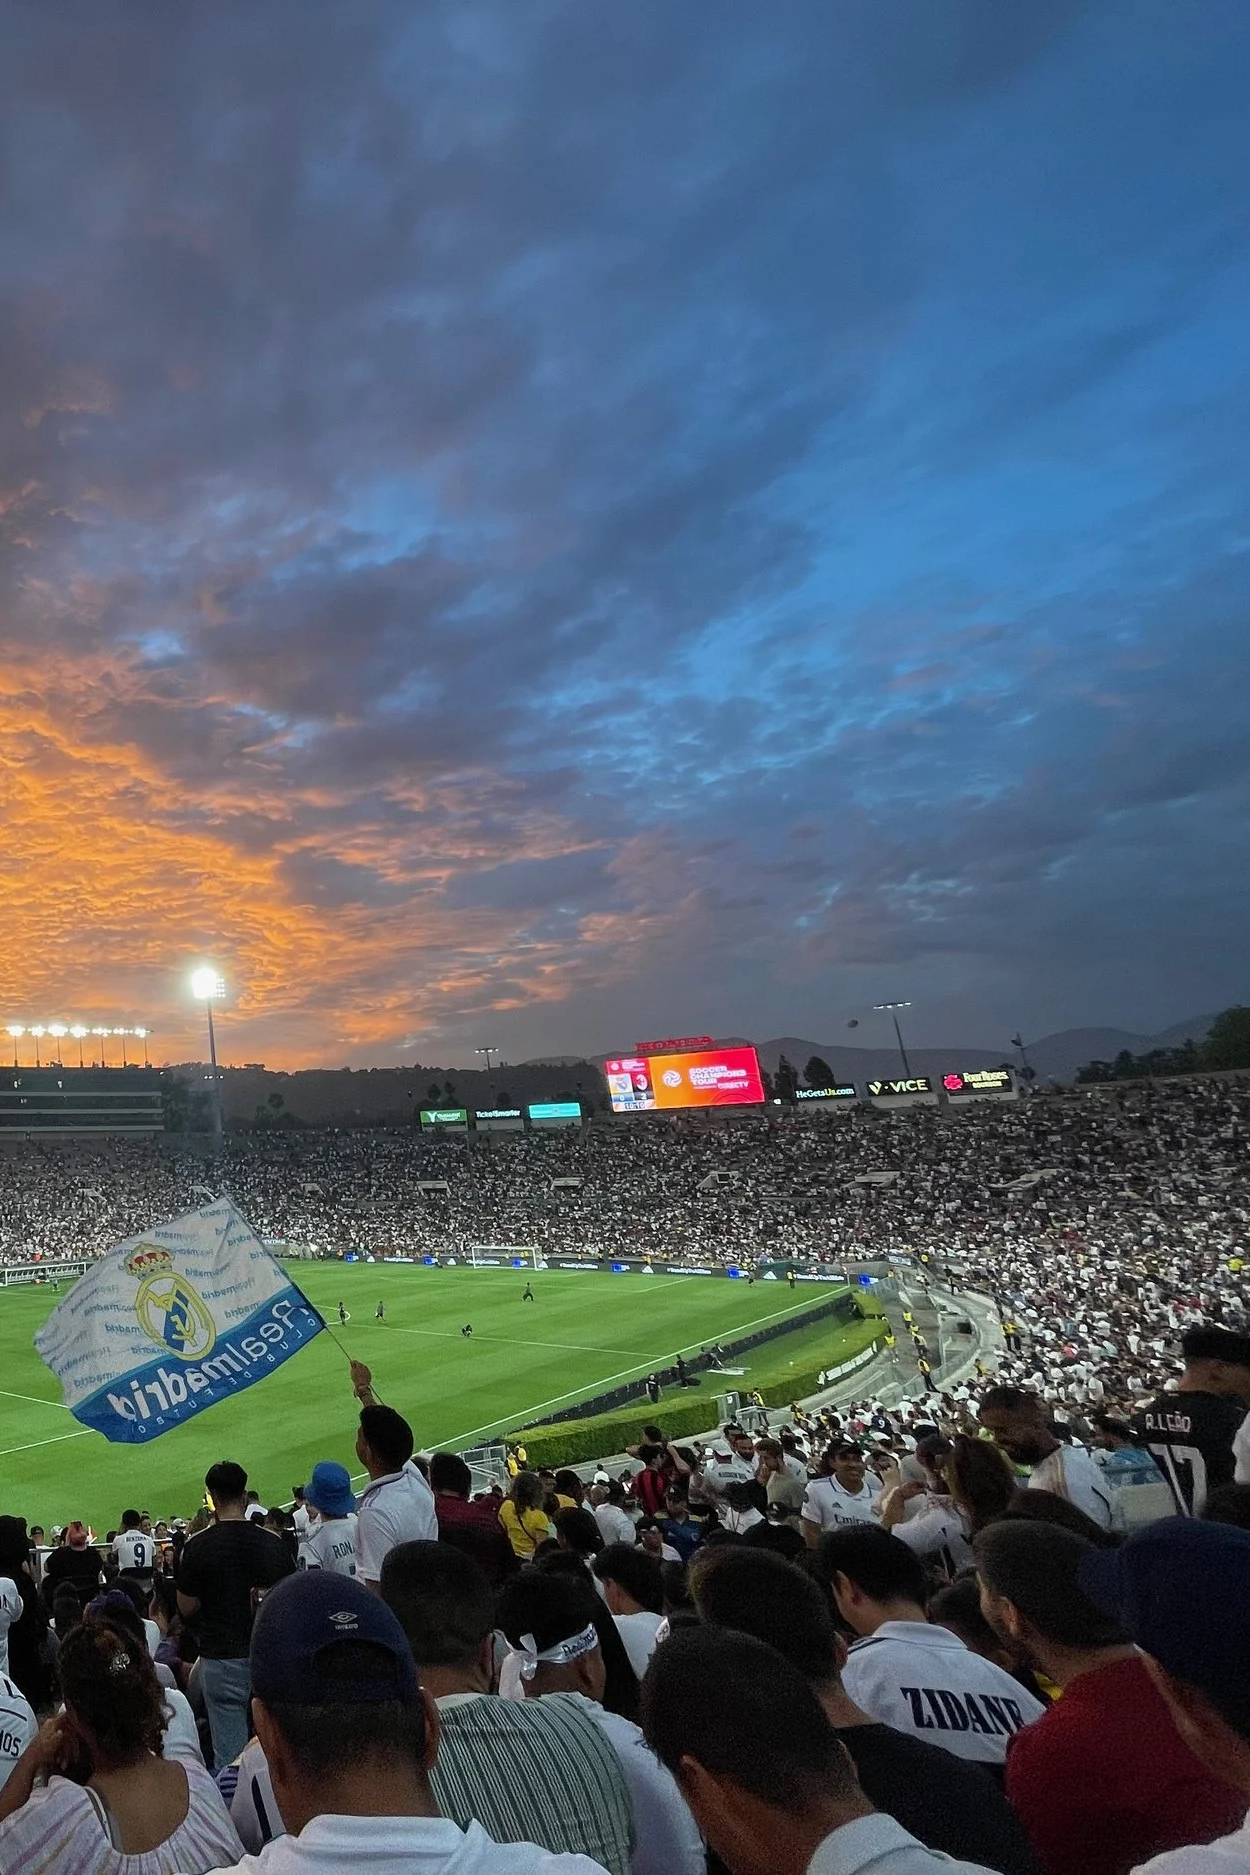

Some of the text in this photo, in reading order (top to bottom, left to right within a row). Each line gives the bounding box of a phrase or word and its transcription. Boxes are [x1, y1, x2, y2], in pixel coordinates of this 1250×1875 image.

[889, 1079, 928, 1093] VICE
[133, 1542, 146, 1568] 9
[331, 1541, 356, 1560] RON
[899, 1686, 1026, 1738] ZIDANE
